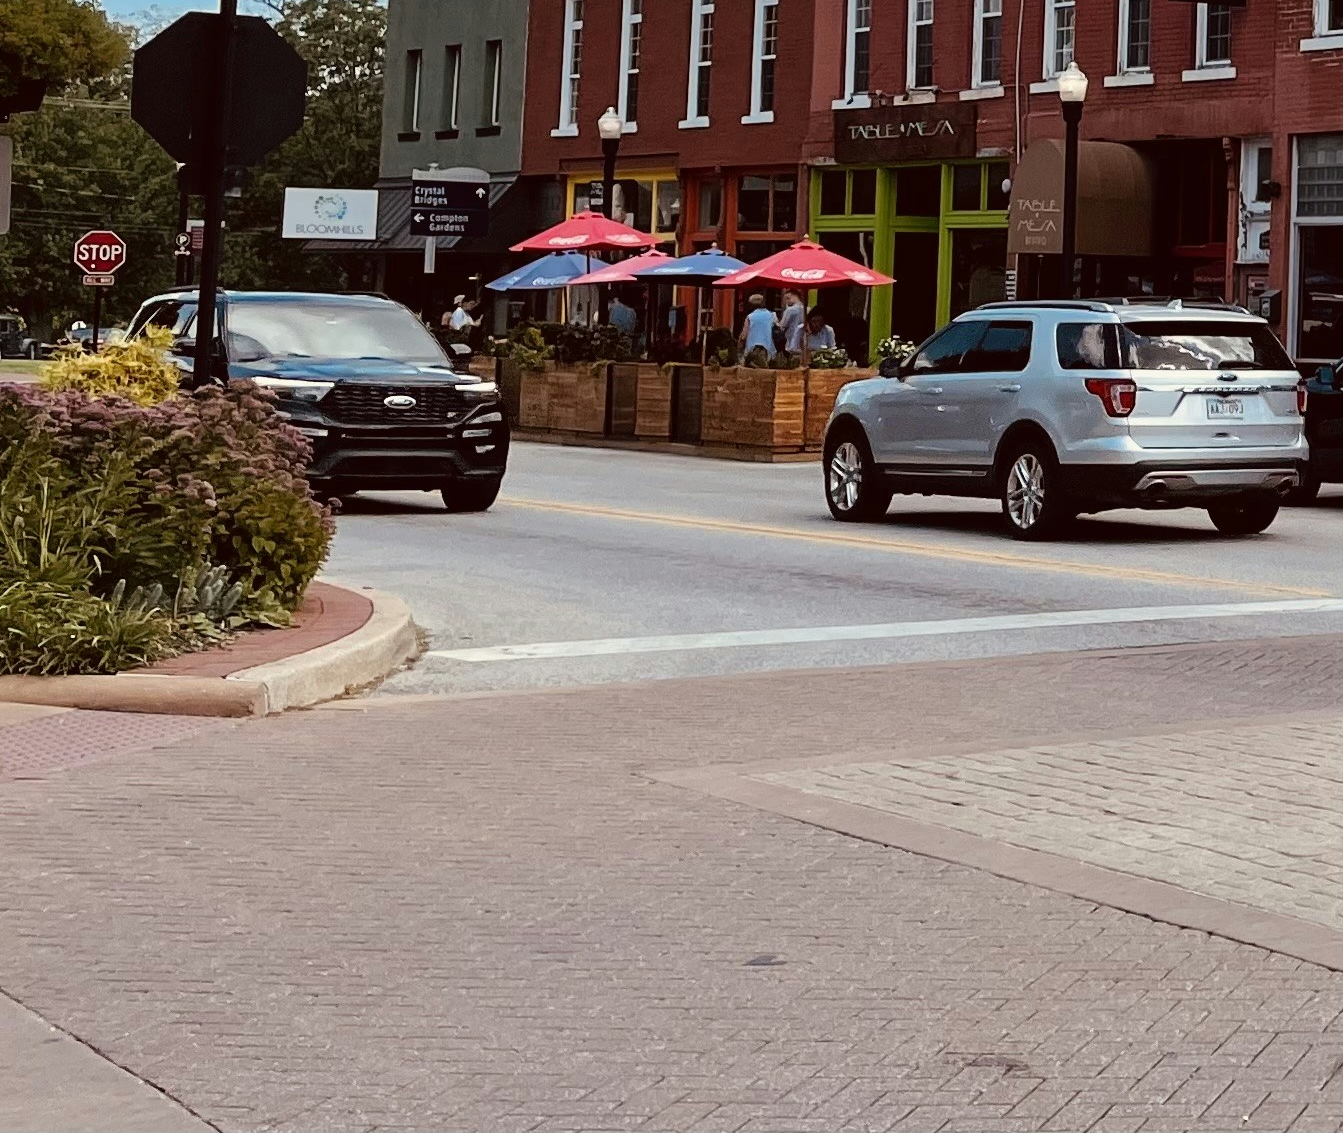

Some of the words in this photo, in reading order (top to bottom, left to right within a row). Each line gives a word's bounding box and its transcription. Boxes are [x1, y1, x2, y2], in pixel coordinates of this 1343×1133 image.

[848, 123, 900, 140] TABLE
[906, 120, 954, 137] MESA
[414, 186, 445, 198] Crystal
[414, 195, 448, 206] Bridges
[1017, 199, 1061, 212] TABLE
[429, 214, 469, 225] Compton
[1017, 218, 1057, 232] MESA
[295, 223, 364, 235] BLOOMHILLS
[429, 222, 465, 232] Gardens
[78, 244, 122, 261] STOP
